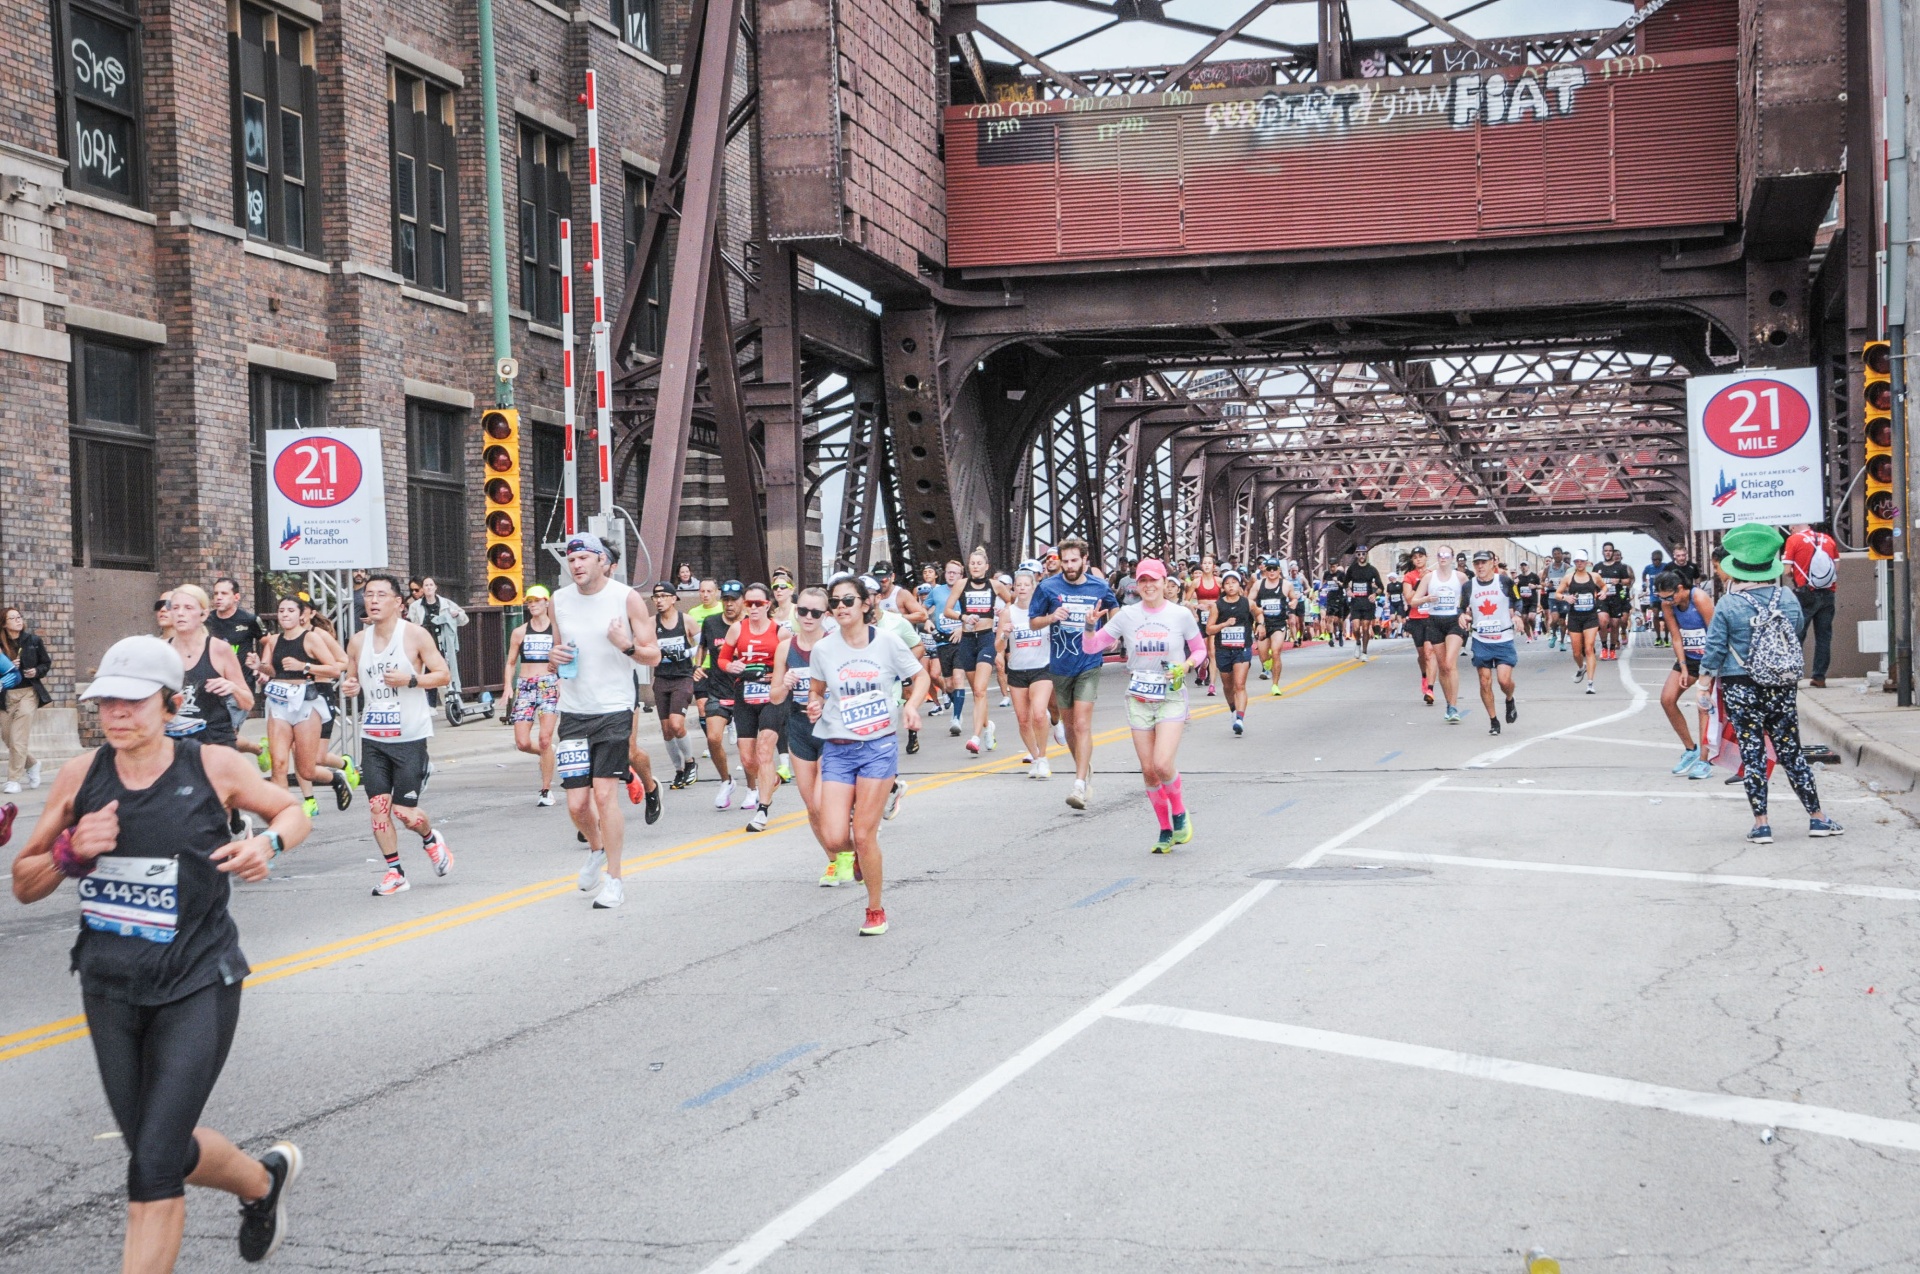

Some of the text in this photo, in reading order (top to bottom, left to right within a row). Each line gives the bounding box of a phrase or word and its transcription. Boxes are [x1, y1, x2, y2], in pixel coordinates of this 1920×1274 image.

[1728, 387, 1780, 434] 21
[1737, 435, 1778, 451] MILE
[294, 445, 338, 484] 21
[1741, 479, 1784, 490] Chicago
[302, 488, 336, 501] MILE
[1741, 489, 1795, 500] Marathon
[304, 527, 340, 537] Chicago
[304, 536, 349, 545] Marathon
[1474, 590, 1499, 599] CANADA
[1136, 629, 1169, 640] Chicago
[839, 668, 879, 681] Chicago
[745, 683, 771, 693] F 2750
[1130, 681, 1165, 693] F 25971
[841, 700, 887, 723] H 32734
[370, 712, 400, 724] 29168
[79, 878, 177, 910] G 44566
